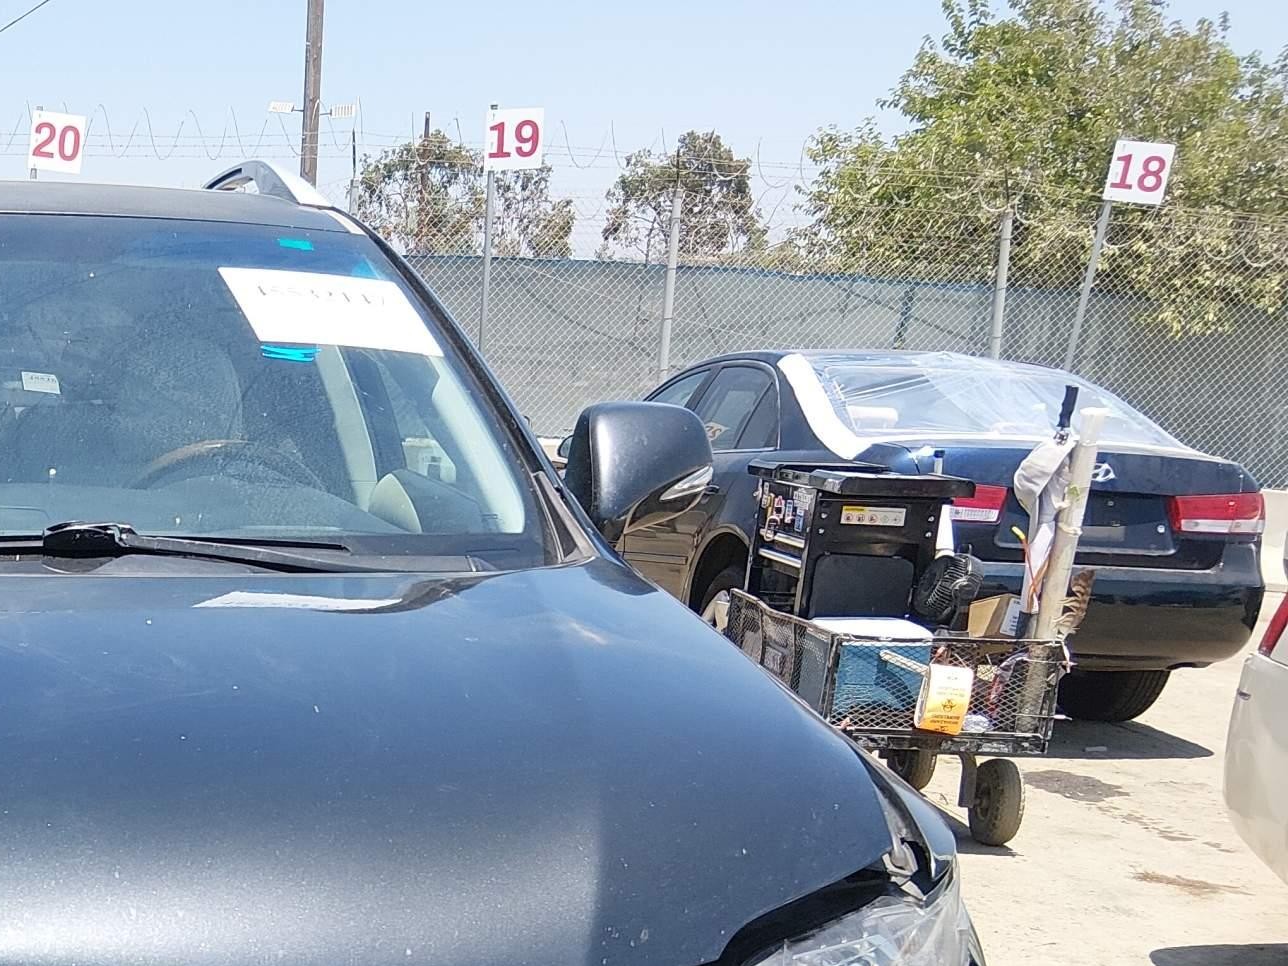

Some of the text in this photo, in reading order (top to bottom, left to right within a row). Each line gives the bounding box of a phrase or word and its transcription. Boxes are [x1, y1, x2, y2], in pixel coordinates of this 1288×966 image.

[32, 122, 80, 161] 20
[488, 119, 540, 158] 19
[1109, 153, 1166, 193] 18
